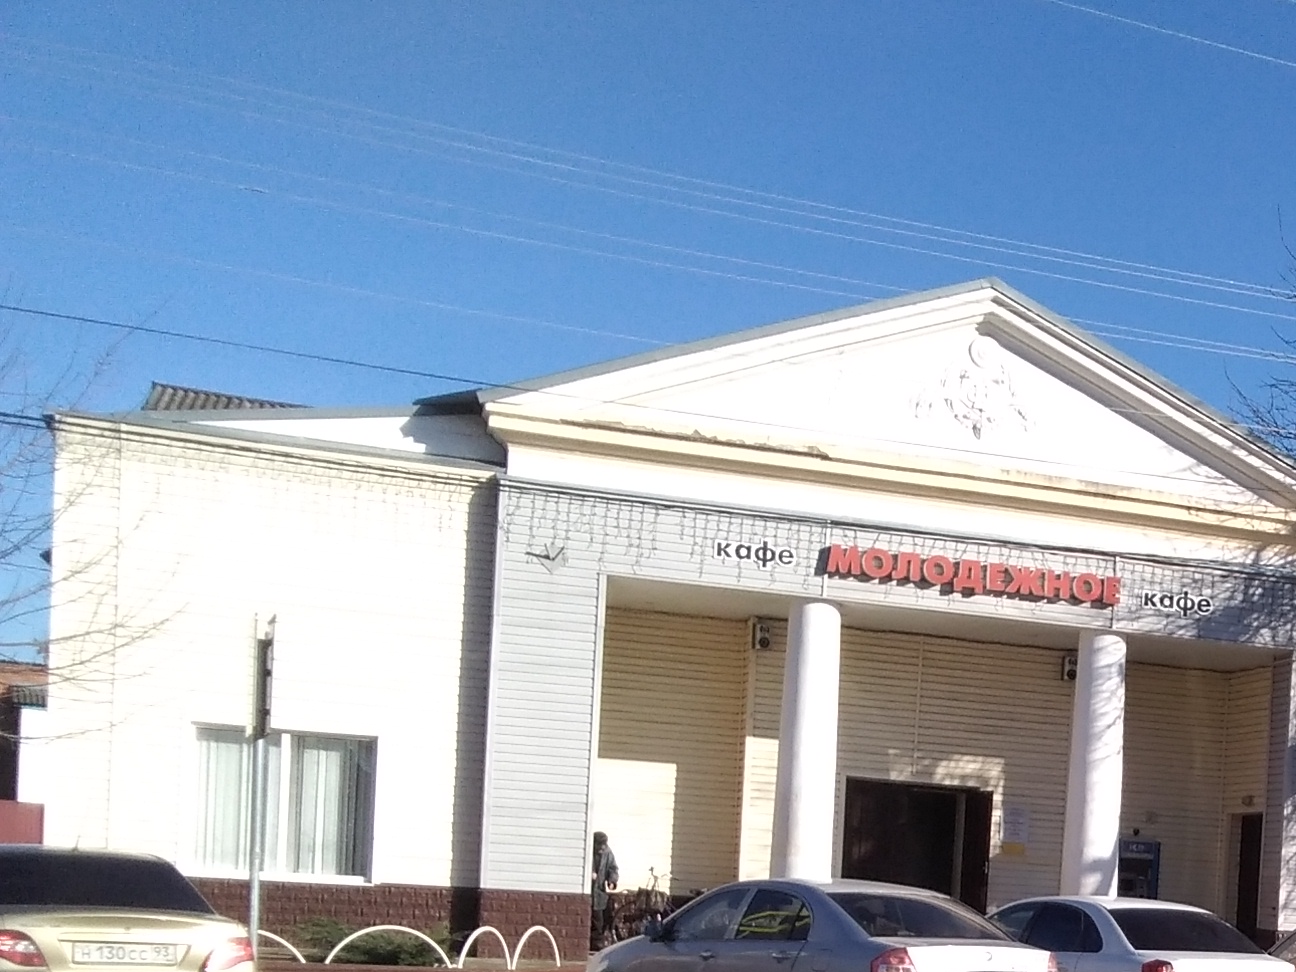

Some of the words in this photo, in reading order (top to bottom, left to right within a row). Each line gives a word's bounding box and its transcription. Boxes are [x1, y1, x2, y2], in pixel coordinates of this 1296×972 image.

[715, 540, 795, 568] кафе
[826, 543, 1121, 606] МОЛОДЕЖНОЕ
[1142, 590, 1212, 618] кафе
